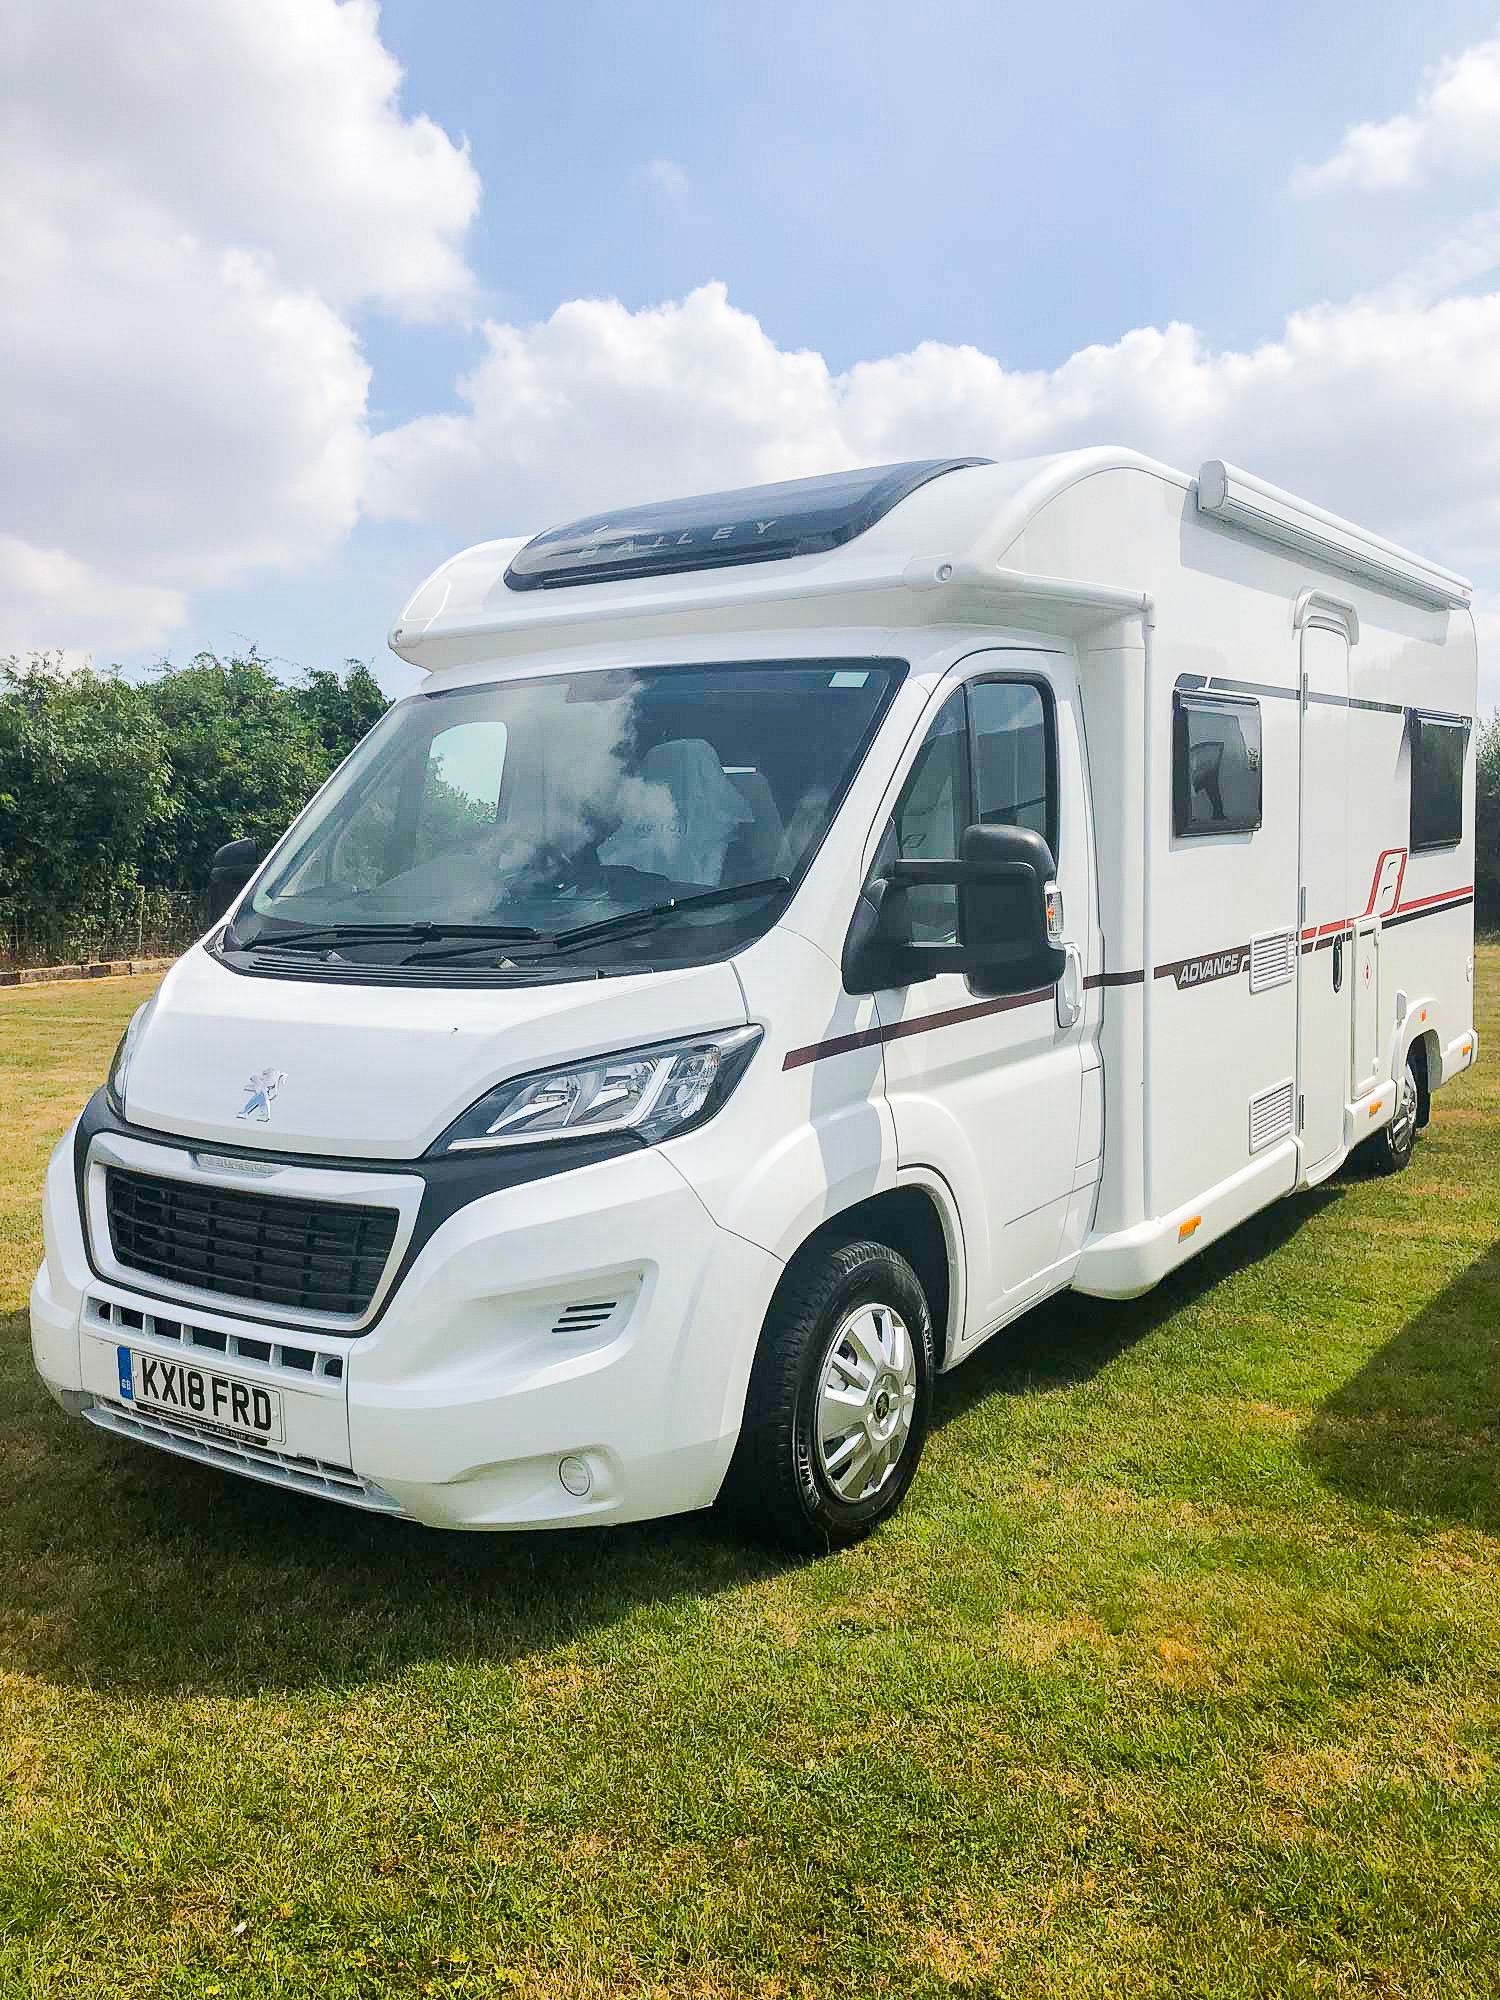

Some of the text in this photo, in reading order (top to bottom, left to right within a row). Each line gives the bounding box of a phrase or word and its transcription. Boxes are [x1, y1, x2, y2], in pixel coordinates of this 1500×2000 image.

[1179, 953, 1239, 985] ADVANCE
[141, 1357, 205, 1411] KX18
[211, 1376, 272, 1431] FRD
